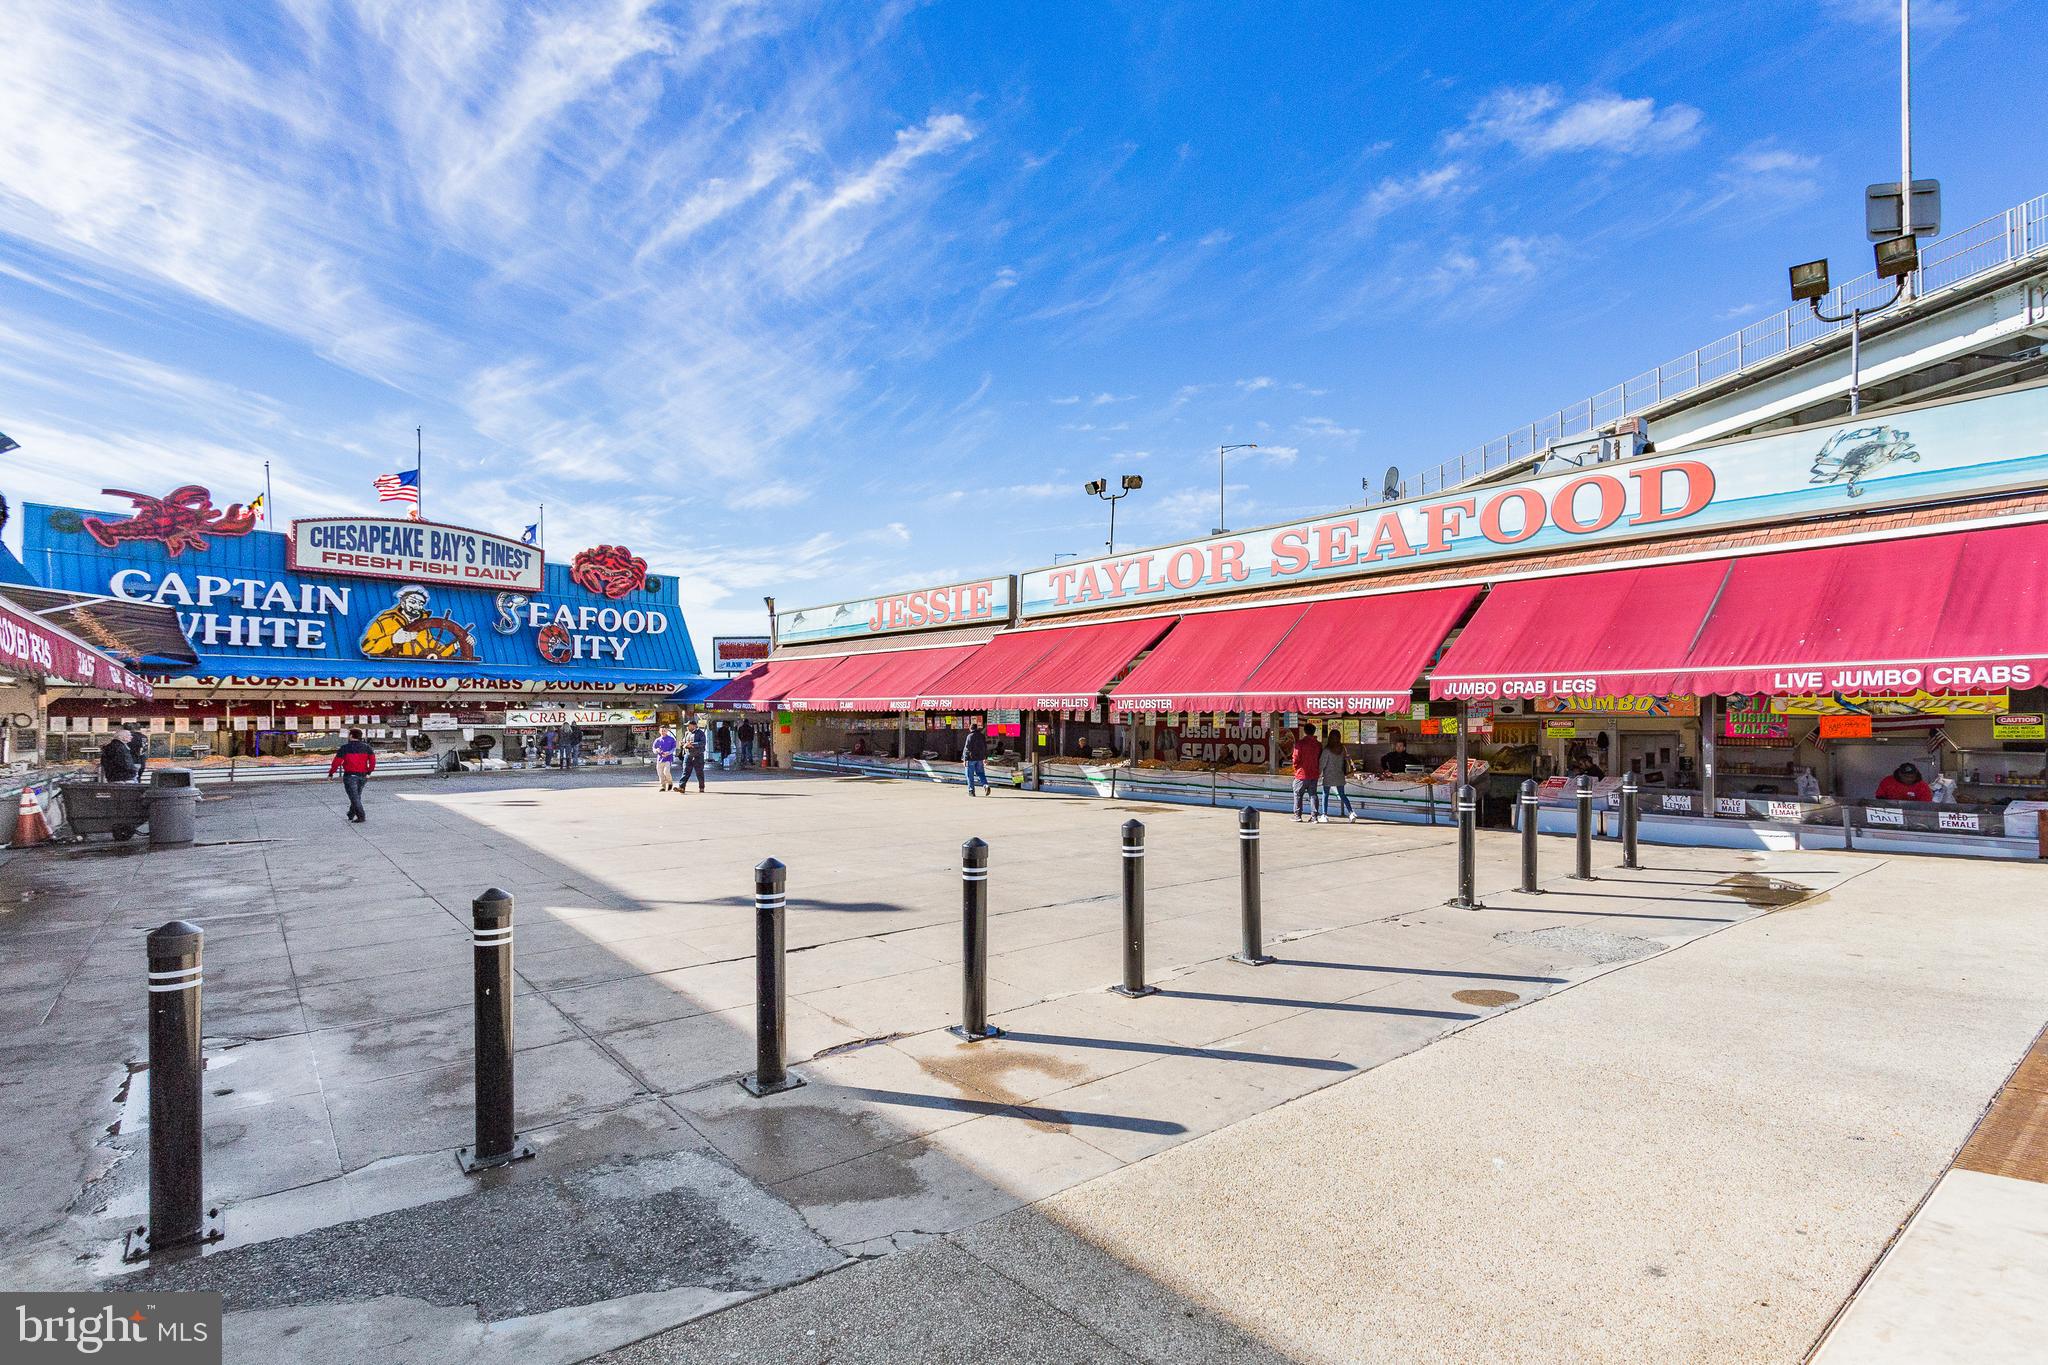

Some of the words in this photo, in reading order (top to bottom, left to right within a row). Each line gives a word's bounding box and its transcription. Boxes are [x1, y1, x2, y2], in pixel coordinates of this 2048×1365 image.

[1048, 539, 1250, 607] TAYLOR
[1270, 459, 1716, 578] SEAFOOD
[310, 525, 424, 558] CHESAPEAKE
[431, 531, 476, 564] BAY'S
[482, 541, 531, 569] FINEST
[322, 551, 402, 571] FRESH
[409, 560, 457, 576] FISH
[464, 566, 523, 582] DAILY
[110, 568, 351, 616] CAPTAIN
[868, 580, 993, 632] JESSIE
[373, 676, 447, 689] JUMBO
[457, 677, 523, 690] CRABS
[1774, 671, 1823, 689] LIVE
[1831, 668, 1922, 687] JUMBO
[1933, 665, 2031, 683] CRABS
[1444, 682, 1497, 695] JUMBO
[1502, 681, 1546, 694] CRAB
[1553, 679, 1597, 693] LEGS
[890, 701, 911, 709] MUSSELS
[921, 699, 939, 707] FRESH
[940, 699, 953, 707] FISH
[1037, 698, 1060, 708] FRESH
[1061, 698, 1088, 708] FILLETS
[1117, 699, 1134, 709] LIVE
[1135, 699, 1172, 709] LOBSTER
[1306, 698, 1343, 709] FRESH
[1348, 698, 1395, 709] SHRIMP
[1567, 694, 1657, 712] JUMBO
[529, 712, 567, 724] CRAB
[574, 712, 607, 723] SALE
[1729, 713, 1784, 723] BUSHEL
[1180, 723, 1220, 739] Jessie
[1225, 724, 1268, 741] Taylor
[1734, 724, 1770, 734] SALE
[1722, 805, 1741, 813] MALE
[1948, 813, 1968, 822] MED
[1941, 820, 1977, 829] FEMALE
